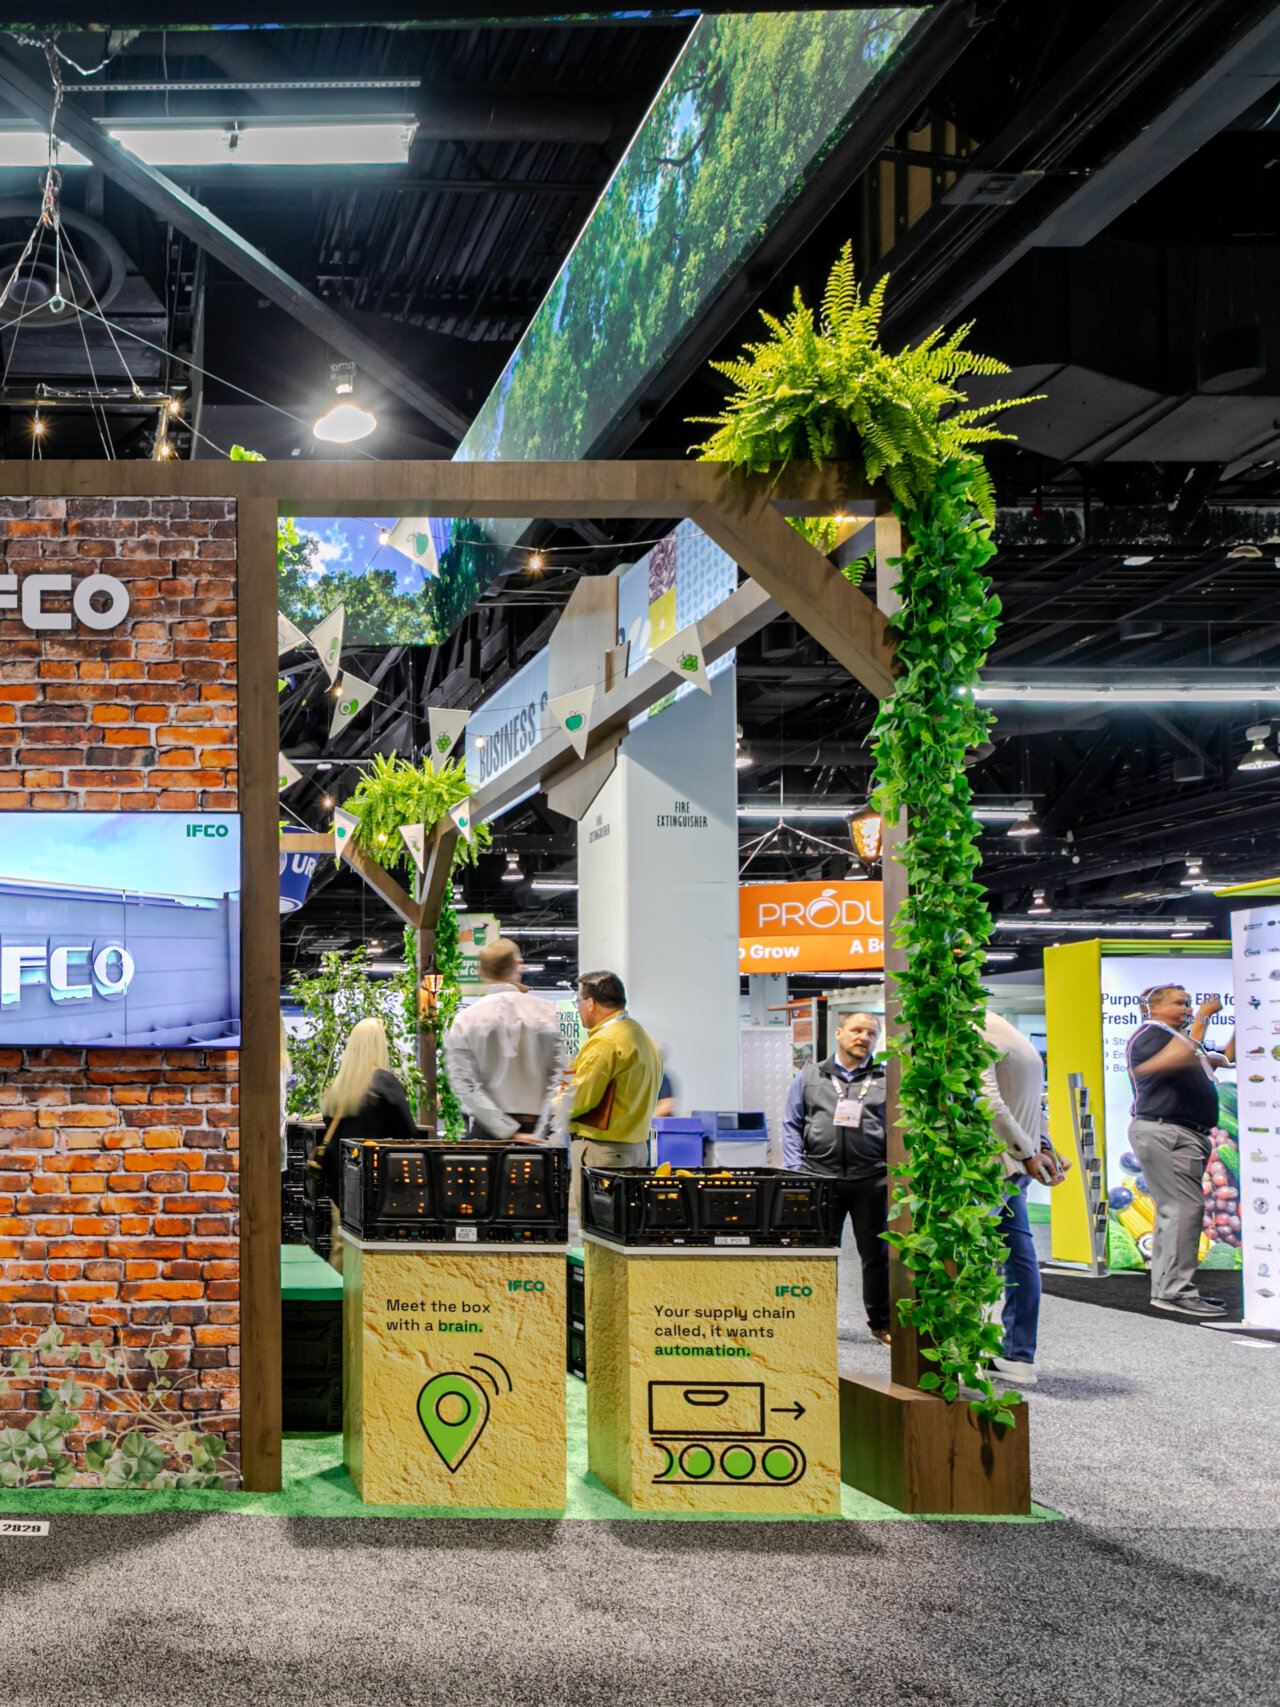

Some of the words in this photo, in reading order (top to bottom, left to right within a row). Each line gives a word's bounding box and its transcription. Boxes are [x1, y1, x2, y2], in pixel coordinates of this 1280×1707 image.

[478, 702, 536, 784] BUSINESS
[674, 801, 691, 814] FIRE
[656, 814, 708, 828] EXTINGUISHER
[186, 824, 229, 838] IFCO
[749, 944, 800, 959] Grow
[849, 940, 864, 955] A
[556, 1011, 580, 1022] EXIBLE
[1102, 1012, 1138, 1025] Fresh
[508, 1280, 545, 1292] IFCO
[775, 1286, 813, 1297] IFCO
[386, 1299, 426, 1312] Meet
[431, 1300, 457, 1313] the
[461, 1300, 491, 1313] box
[654, 1305, 690, 1318] Your
[694, 1306, 748, 1321] supply
[752, 1306, 796, 1319] chain
[386, 1318, 420, 1331] with
[425, 1322, 434, 1331] a
[438, 1319, 483, 1333] brain.
[654, 1325, 706, 1339] called,
[710, 1325, 721, 1337] it
[726, 1326, 774, 1338] wants
[654, 1345, 751, 1357] automation.
